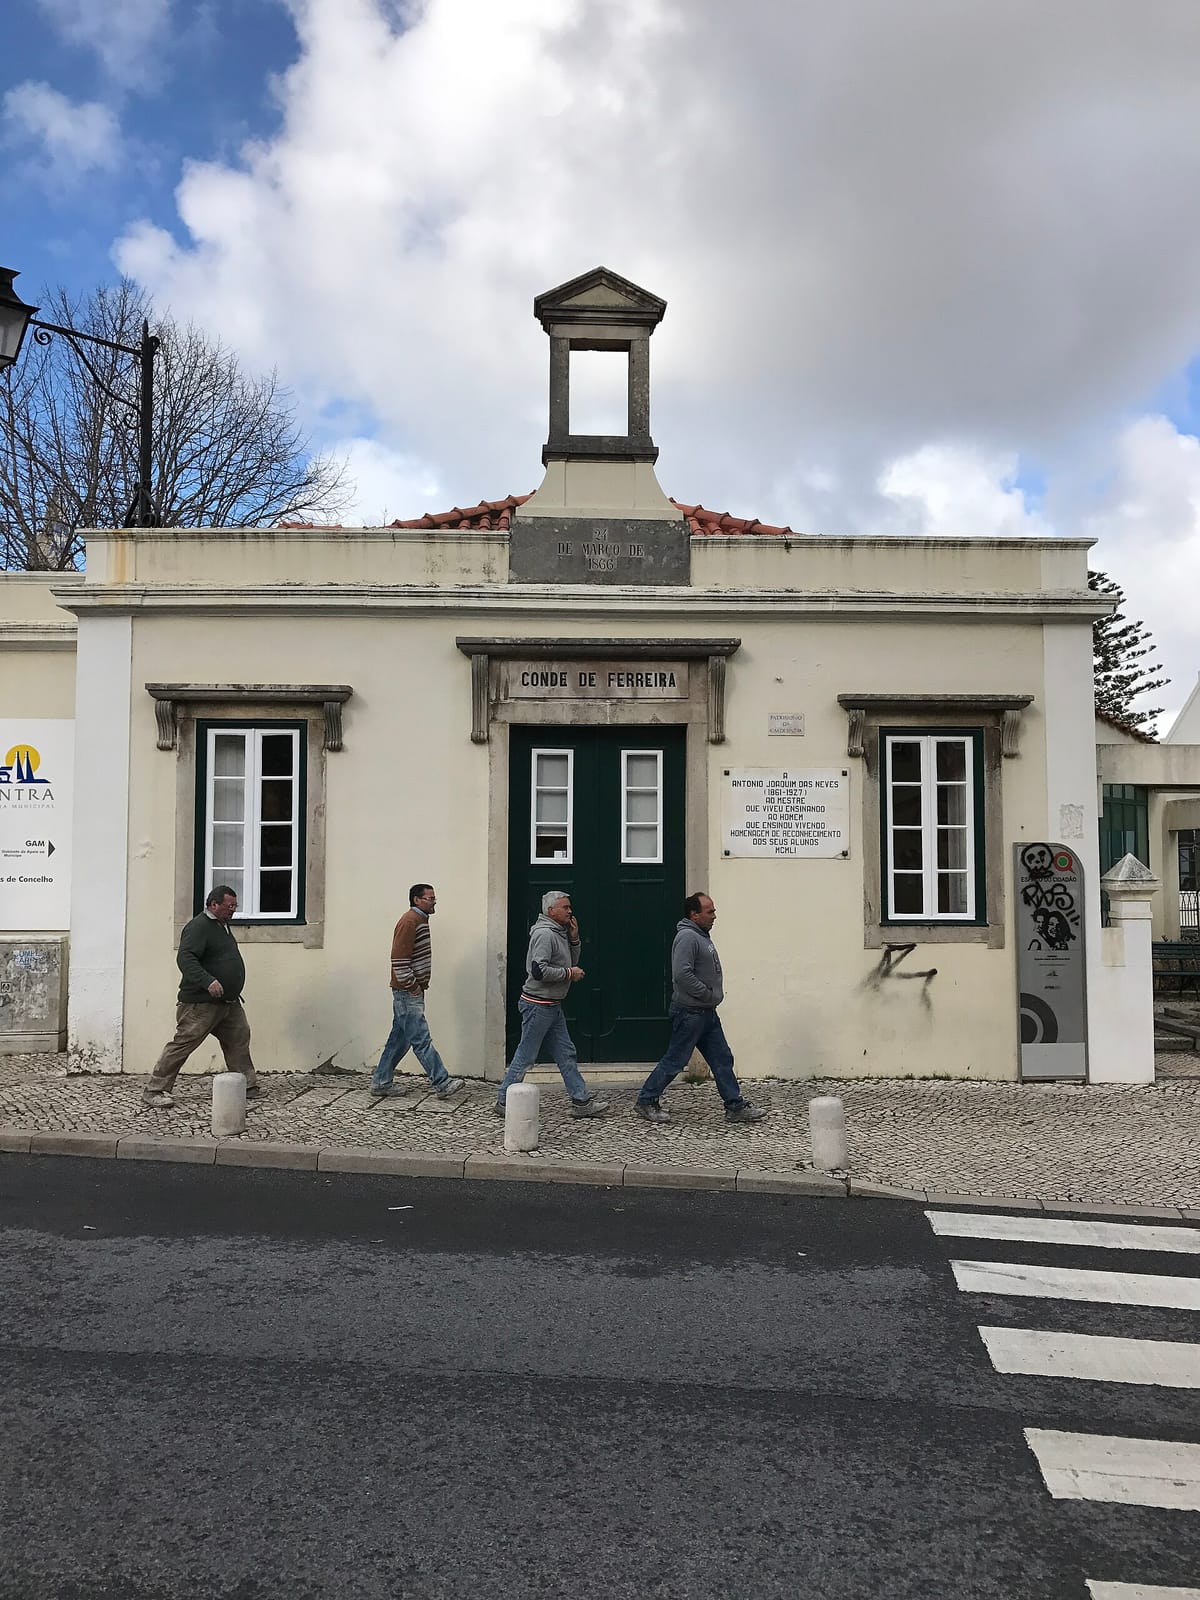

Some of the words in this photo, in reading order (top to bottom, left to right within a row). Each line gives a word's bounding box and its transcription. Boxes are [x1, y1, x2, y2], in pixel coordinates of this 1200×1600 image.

[593, 528, 608, 541] 24
[557, 542, 573, 555] DE
[582, 543, 620, 557] MARÇO
[629, 544, 644, 557] DE
[588, 558, 614, 570] 1866
[521, 671, 568, 687] CONDE
[578, 672, 597, 687] DE
[607, 672, 677, 688] FERREIRA
[732, 780, 764, 788] ANTONIO
[766, 780, 797, 788] JOAQUIM
[798, 780, 813, 788] DAS
[815, 780, 839, 788] NEVES
[785, 805, 826, 813] ENSINANDO
[745, 821, 760, 829] QUE
[762, 821, 793, 829] ENSINOU
[782, 830, 841, 838] RECONHECIMENTO
[752, 838, 767, 846] DOS
[769, 838, 788, 846] SEUS
[790, 838, 819, 846] ALUNOS
[6, 875, 17, 883] de
[18, 875, 54, 883] Concelho
